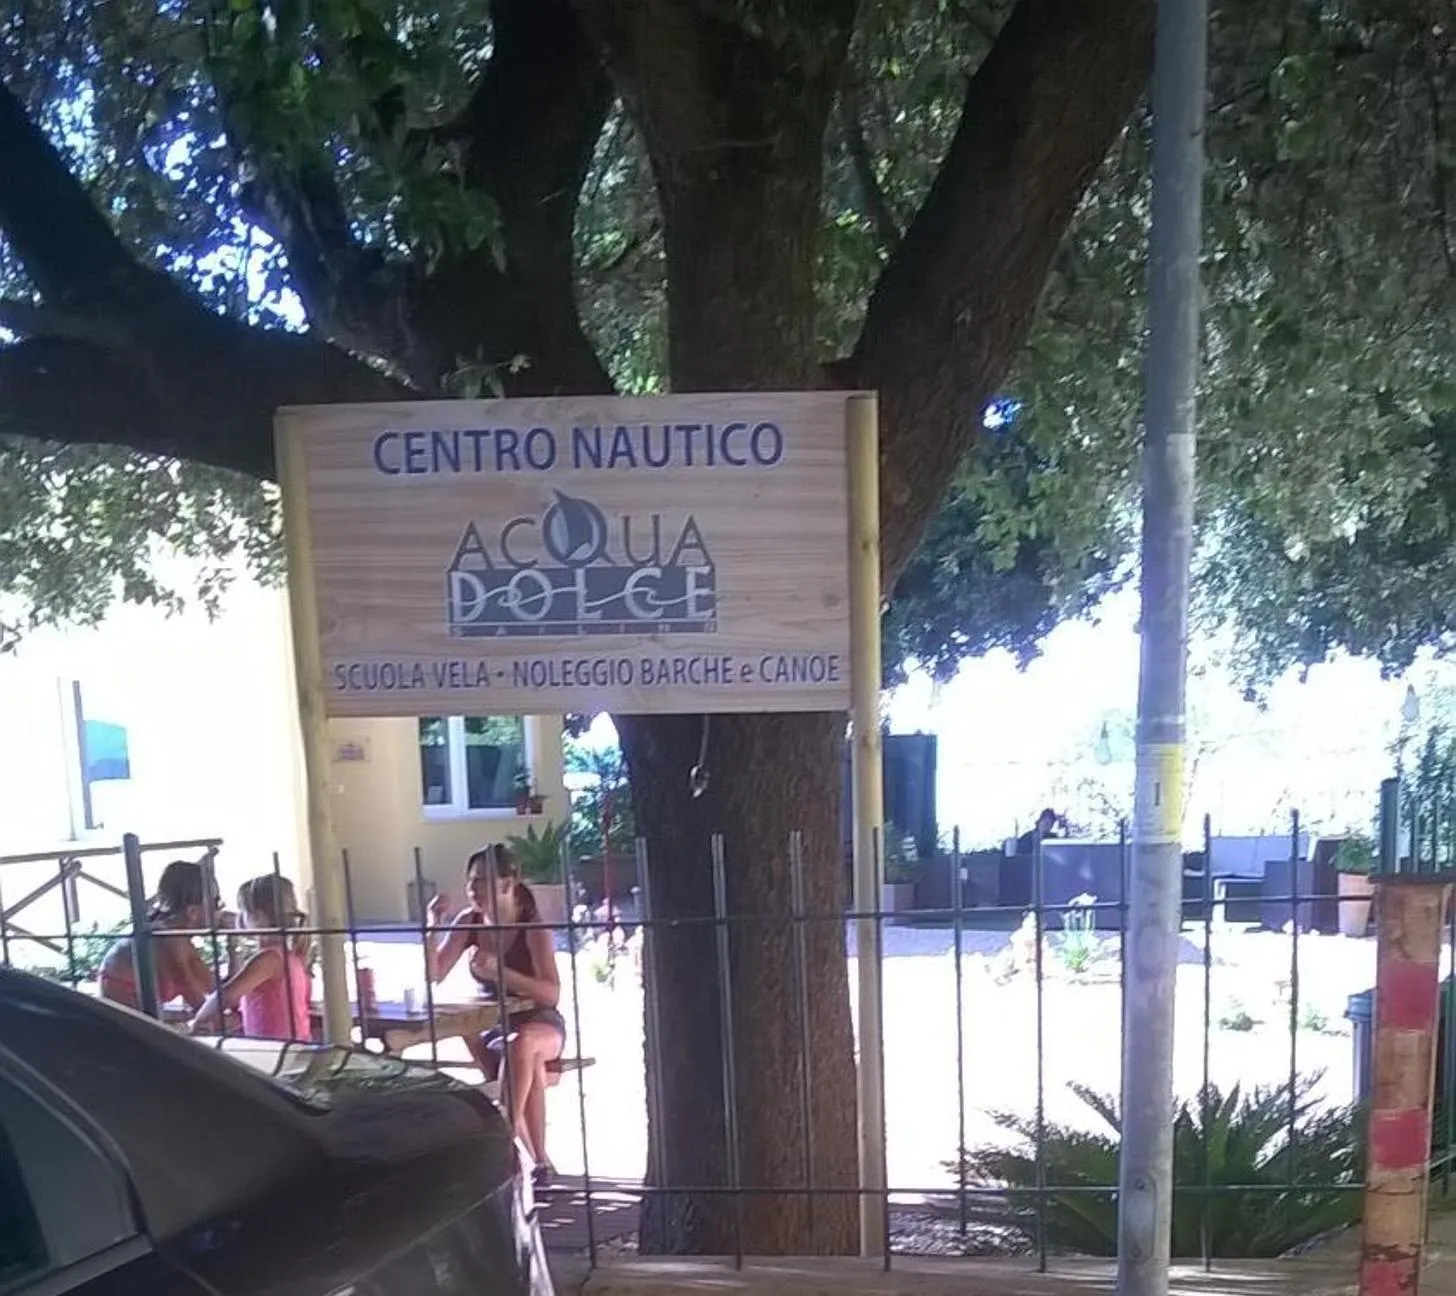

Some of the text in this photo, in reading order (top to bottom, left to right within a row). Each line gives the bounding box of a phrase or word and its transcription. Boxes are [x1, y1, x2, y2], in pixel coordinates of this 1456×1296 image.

[373, 422, 784, 475] CENTRO NAUTICO
[447, 488, 716, 573] ACQUA
[449, 566, 716, 622] DOLCE
[334, 655, 841, 691] SCUOLA VELA NOLEGGIO BARCHE e CANOE
